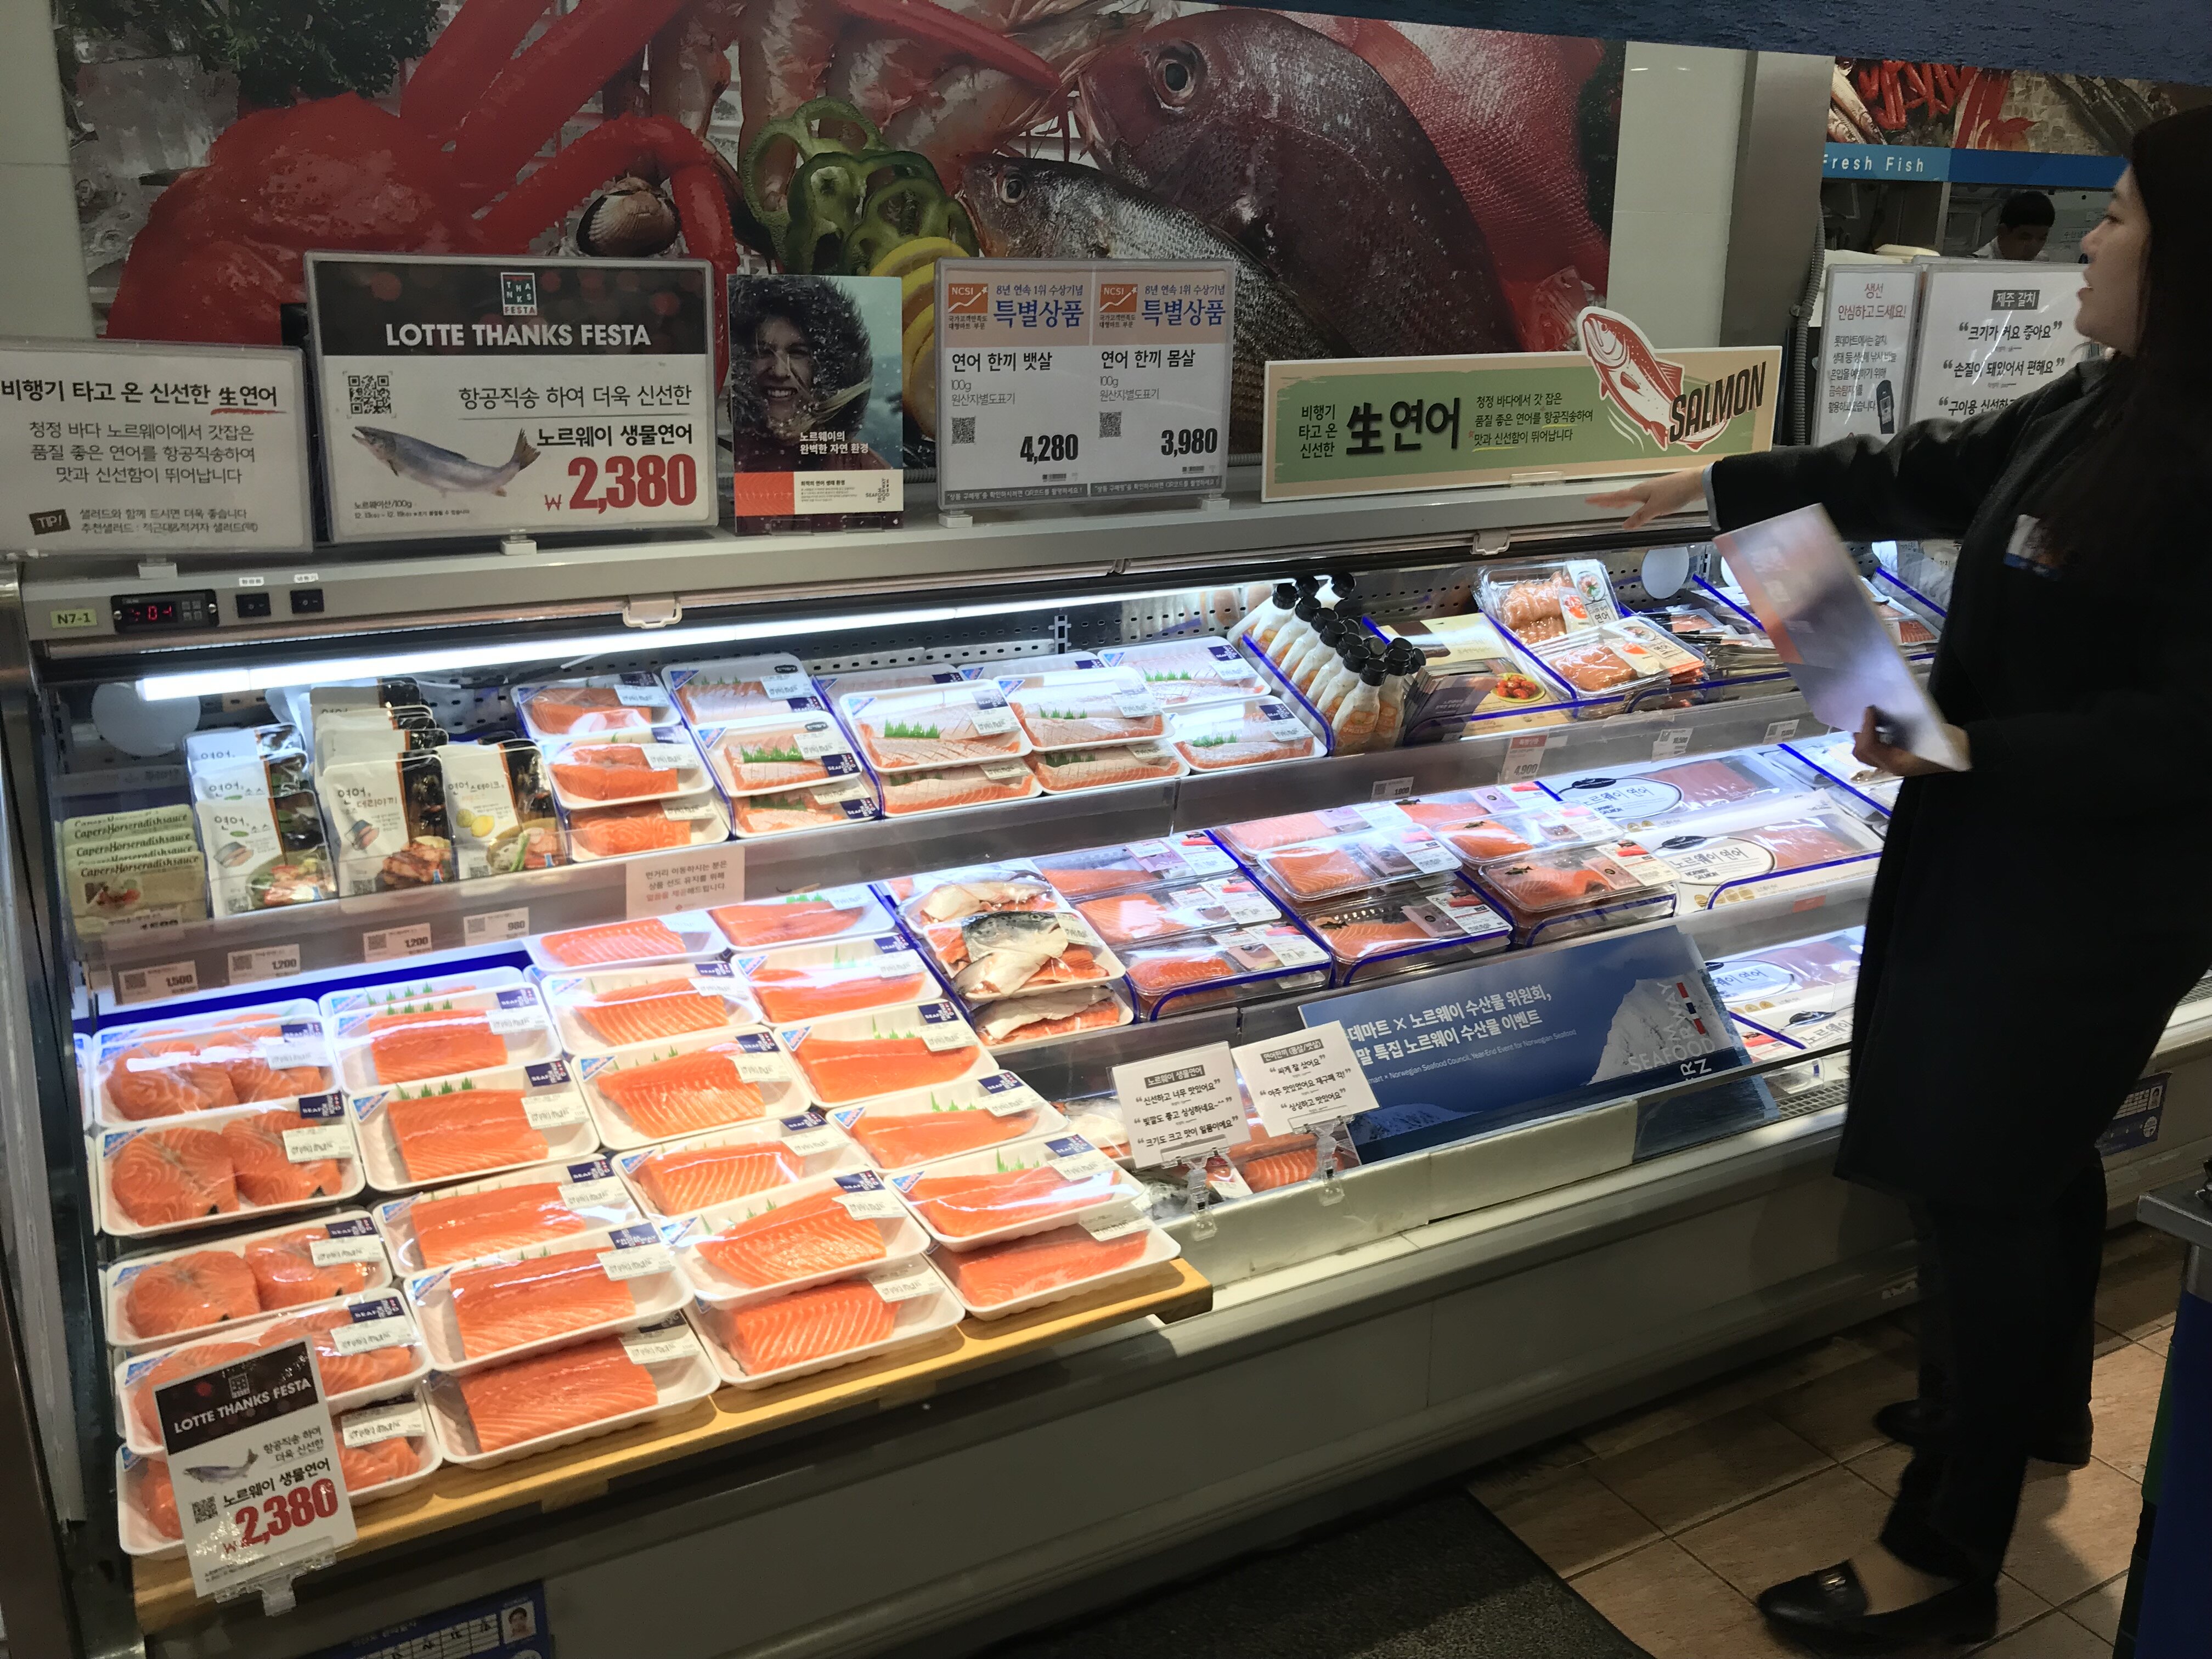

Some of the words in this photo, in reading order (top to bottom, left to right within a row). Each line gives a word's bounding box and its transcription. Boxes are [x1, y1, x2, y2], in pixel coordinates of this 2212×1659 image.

[1886, 157, 1923, 172] Fish
[996, 285, 1011, 295] 8년
[1014, 285, 1031, 295] 연속
[1034, 285, 1046, 296] 1위
[1049, 285, 1084, 296] 수상기념
[1145, 285, 1158, 295] 8년
[1161, 285, 1177, 295] 연속
[1180, 285, 1190, 295] 1위
[1193, 285, 1225, 295] 수상기념
[1865, 283, 1884, 298] 생선
[1996, 292, 2015, 307] 제주
[2018, 291, 2036, 306] 갈치
[994, 300, 1084, 329] 특별상품
[1142, 299, 1226, 326] 특별상품
[1838, 305, 1874, 320] 안심하고
[386, 324, 465, 346] LOTTE
[472, 324, 573, 346] THANKS
[582, 324, 651, 346] FESTA
[952, 353, 981, 373] 연어
[988, 353, 1017, 371] 한끼
[1023, 352, 1052, 371] 뱃살
[1101, 351, 1128, 369] 연어
[1135, 349, 1162, 368] 한끼
[1167, 349, 1195, 368] 몸살
[951, 380, 972, 392] 100g
[1099, 376, 1119, 387] 100g
[1, 380, 64, 401] 비행기
[72, 381, 115, 403] 타고
[121, 383, 143, 403] 온
[150, 383, 210, 405] 신선한
[218, 386, 277, 407] 生연어
[459, 386, 539, 410] 항공직송
[546, 386, 584, 409] 하여
[593, 386, 630, 408] 더욱
[636, 385, 691, 407] 신선한
[1476, 395, 1493, 408] 청정
[1497, 394, 1531, 407] 바다에서
[1534, 394, 1542, 405] 갓
[1545, 393, 1562, 405] 잡은
[1669, 361, 1766, 443] SALMON
[1301, 404, 1335, 420] 비행기
[1475, 414, 1493, 427] 품질
[1496, 413, 1513, 426] 좋은
[1516, 412, 1541, 425] 연어를
[1545, 409, 1593, 425] 항공직송하여
[30, 422, 61, 438] 청정
[68, 423, 101, 438] 바다
[108, 424, 202, 440] 노르웨이에서
[208, 424, 254, 441] 갓잡은
[1299, 425, 1322, 439] 타고
[1325, 424, 1338, 439] 온
[1345, 397, 1461, 455] 生연어
[537, 426, 612, 447] 노르웨이
[620, 424, 692, 446] 생물연어
[799, 431, 845, 442] 노르웨이의
[1161, 428, 1217, 458] 3,980
[1474, 434, 1492, 446] 맛과
[1495, 432, 1529, 445] 신선함이
[1531, 430, 1573, 443] 뛰어납니다
[30, 445, 63, 460] 품질
[70, 446, 103, 460] 좋은
[110, 445, 157, 462] 연어를
[164, 446, 255, 462] 항공직송하여
[800, 444, 828, 454] 완벽한
[831, 444, 849, 454] 자연
[851, 443, 868, 454] 환경
[1020, 434, 1078, 464] 4,280
[1301, 442, 1335, 458] 신선한
[56, 467, 89, 483] 맛과
[95, 468, 159, 483] 신선함이
[165, 468, 242, 484] 뛰어납니다
[568, 453, 697, 514] 2,380
[37, 515, 63, 530] TIP!
[57, 612, 91, 625] N7-1
[1627, 787, 1654, 797] 연어
[1668, 851, 1722, 870] 노르웨이
[1719, 848, 1749, 860] 연어
[1739, 969, 1768, 981] 연어
[1347, 1019, 1391, 1042] 데마트
[1409, 1005, 1465, 1029] 노르웨이
[1465, 994, 1506, 1017] 수산물
[1506, 984, 1551, 1006] 위원회,
[1375, 1040, 1404, 1060] 특집
[1404, 1027, 1459, 1054] 노르웨이
[1461, 1018, 1502, 1039] 수산물
[1502, 1009, 1542, 1030] 이벤트
[1263, 1049, 1289, 1060] 연어한끼
[1389, 1065, 1421, 1080] Norwegian
[1422, 1058, 1447, 1072] Seafood
[1470, 1048, 1497, 1060] Year-End
[1498, 1044, 1513, 1054] Event
[1514, 1042, 1522, 1050] for
[1523, 1034, 1553, 1048] Norwegian
[1553, 1028, 1577, 1040] Seafood
[1628, 1037, 1715, 1073] SEAFOOD
[1148, 1074, 1175, 1086] 노르웨이
[1176, 1066, 1201, 1079] 생물연어
[1172, 1088, 1185, 1098] 너무
[1165, 1111, 1180, 1121] 좋고
[1169, 1132, 1182, 1141] 크고
[1184, 1127, 1198, 1137] 맛이
[174, 1410, 216, 1434] LOTTE
[217, 1390, 270, 1419] THANKS
[273, 1377, 311, 1398] FESTA
[223, 1479, 275, 1508] 노르웨이
[279, 1458, 331, 1487] 생물연어
[235, 1478, 338, 1545] 2,380
